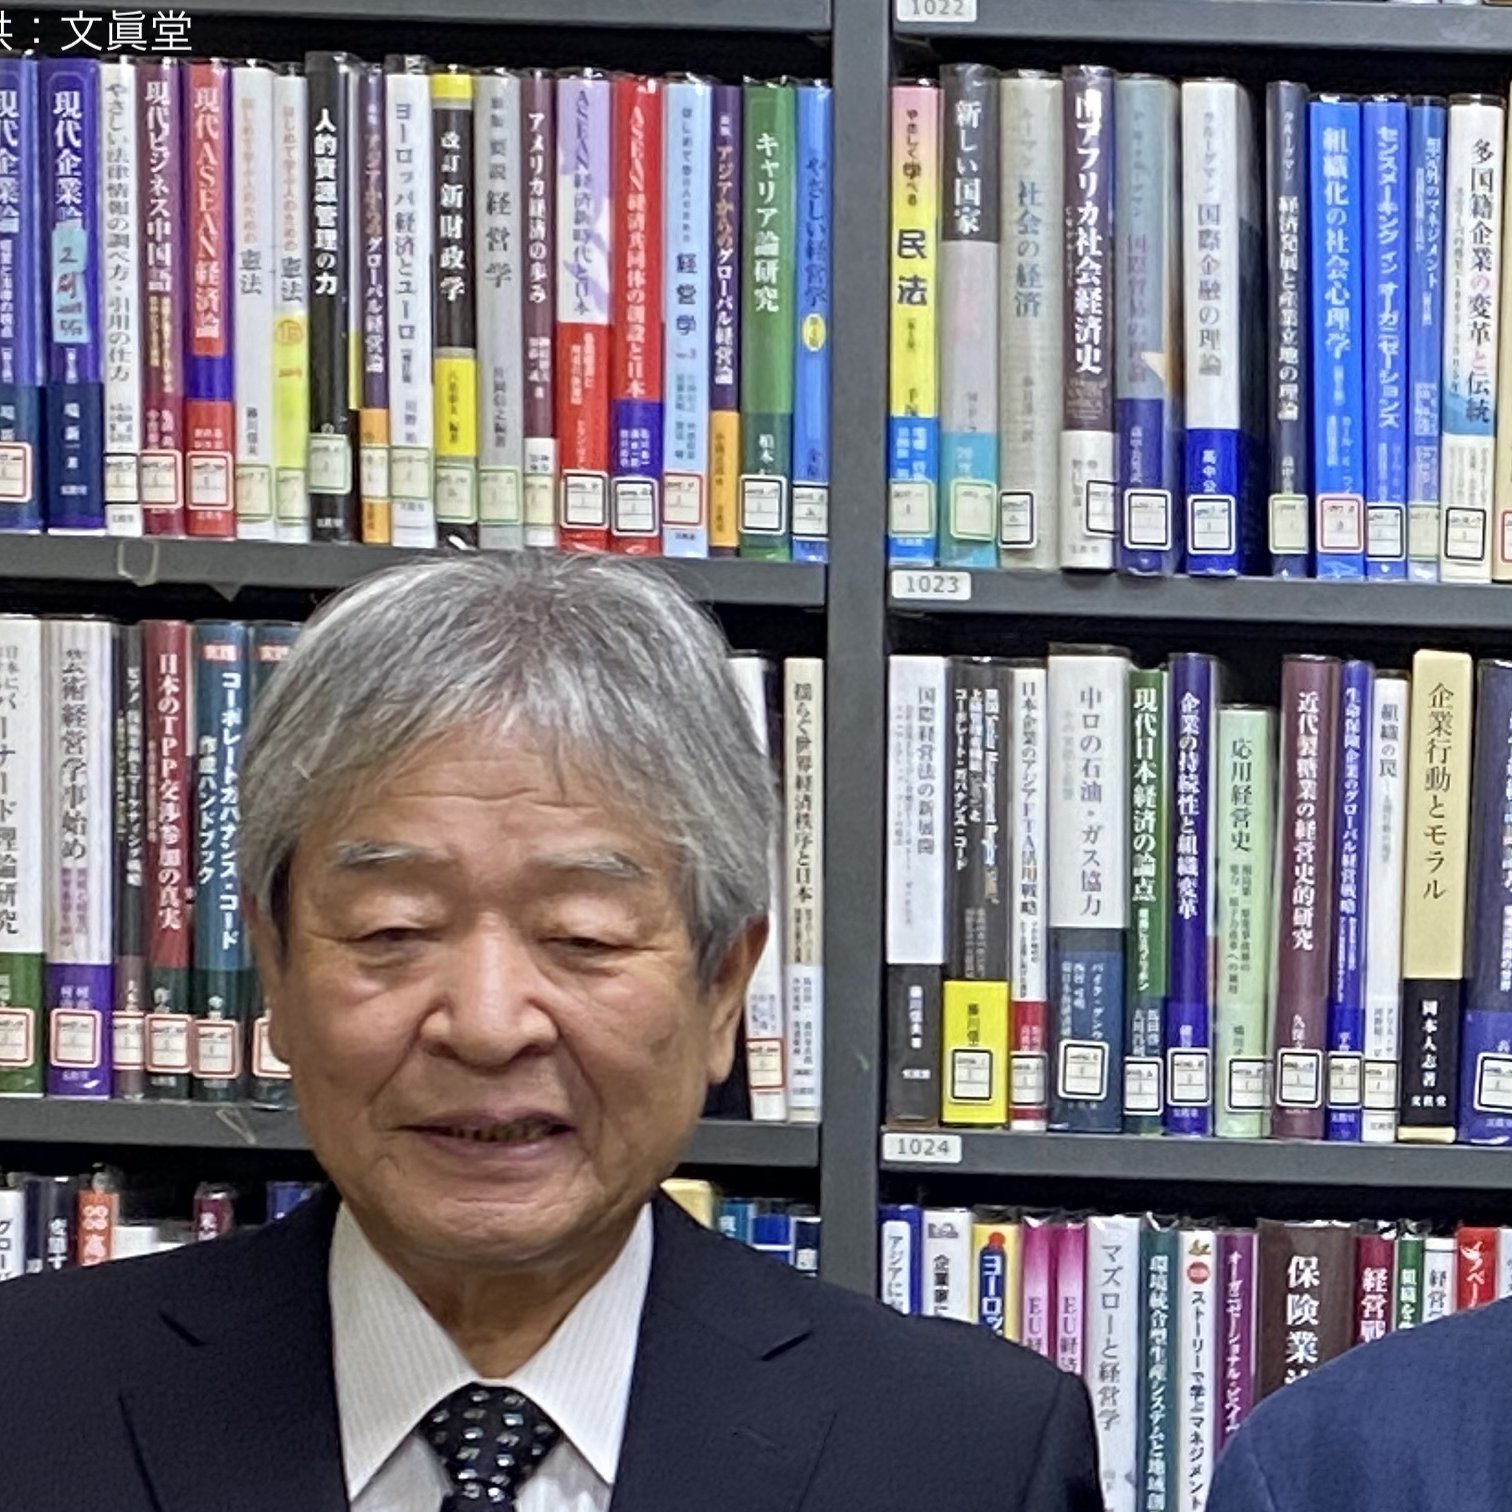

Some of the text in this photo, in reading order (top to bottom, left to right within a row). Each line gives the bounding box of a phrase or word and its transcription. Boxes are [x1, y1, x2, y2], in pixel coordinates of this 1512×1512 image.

[913, 0, 963, 15] 1022
[145, 82, 172, 292] 現代ビジネス中国語
[440, 183, 466, 301] 新財政学
[486, 194, 512, 289] 経営学
[528, 112, 547, 303] アメリカ経済の歩み
[755, 131, 779, 313] キャリア論研究
[955, 99, 983, 234] 新しい国家
[676, 255, 698, 336] 経営学
[898, 229, 928, 306] 民法
[1015, 181, 1042, 318] 社会の経済
[1197, 204, 1222, 378] 国際金融の理論
[1322, 127, 1349, 362] 組織化の社会心理学
[1466, 138, 1495, 425] 多国籍企業の変革と伝統
[906, 576, 960, 593] 1023
[1079, 685, 1102, 918] 中ロの石油・ガス協力
[1133, 687, 1157, 903] 現代日本経済の論点
[1229, 736, 1253, 853] 応用経営史
[1424, 682, 1456, 900] 企業行動とモラル
[896, 1139, 951, 1155] 1024
[982, 1255, 1004, 1336] ヨーロッ
[1096, 1243, 1123, 1432] マズローと経営学
[1189, 1289, 1207, 1511] ストーリーで学ぶマネジメント
